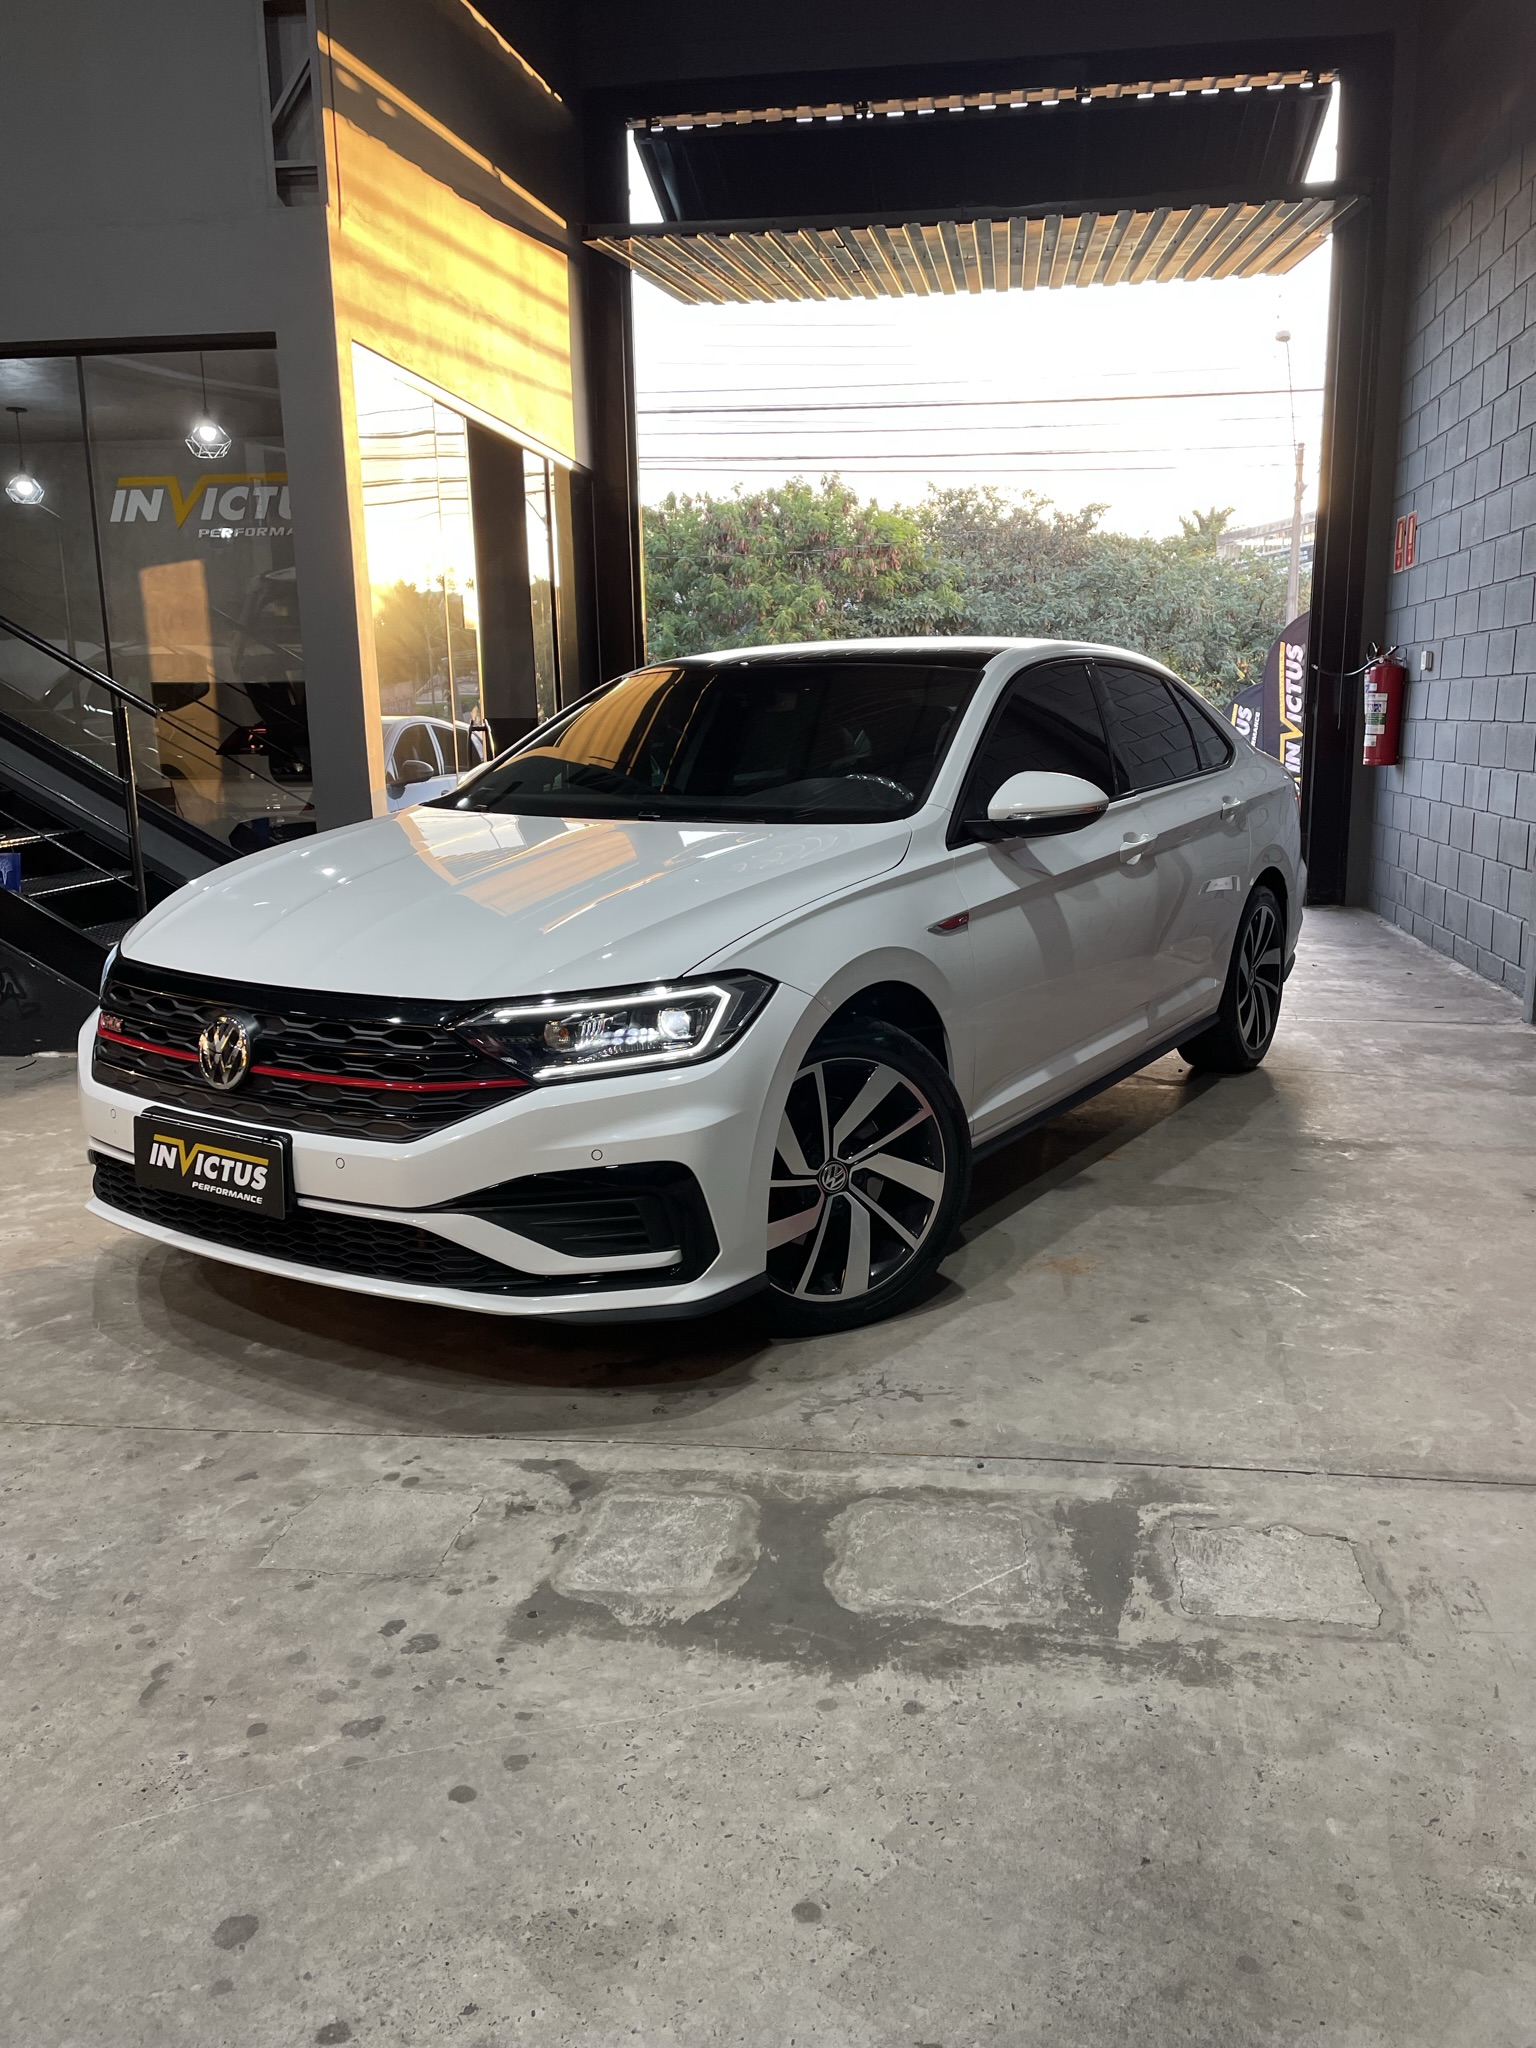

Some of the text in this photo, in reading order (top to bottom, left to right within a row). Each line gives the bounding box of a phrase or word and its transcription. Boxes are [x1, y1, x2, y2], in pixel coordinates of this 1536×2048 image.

[1280, 642, 1304, 773] INVICTUS
[149, 1134, 270, 1191] INVICTUS
[192, 1181, 264, 1205] PERFORMANCE
